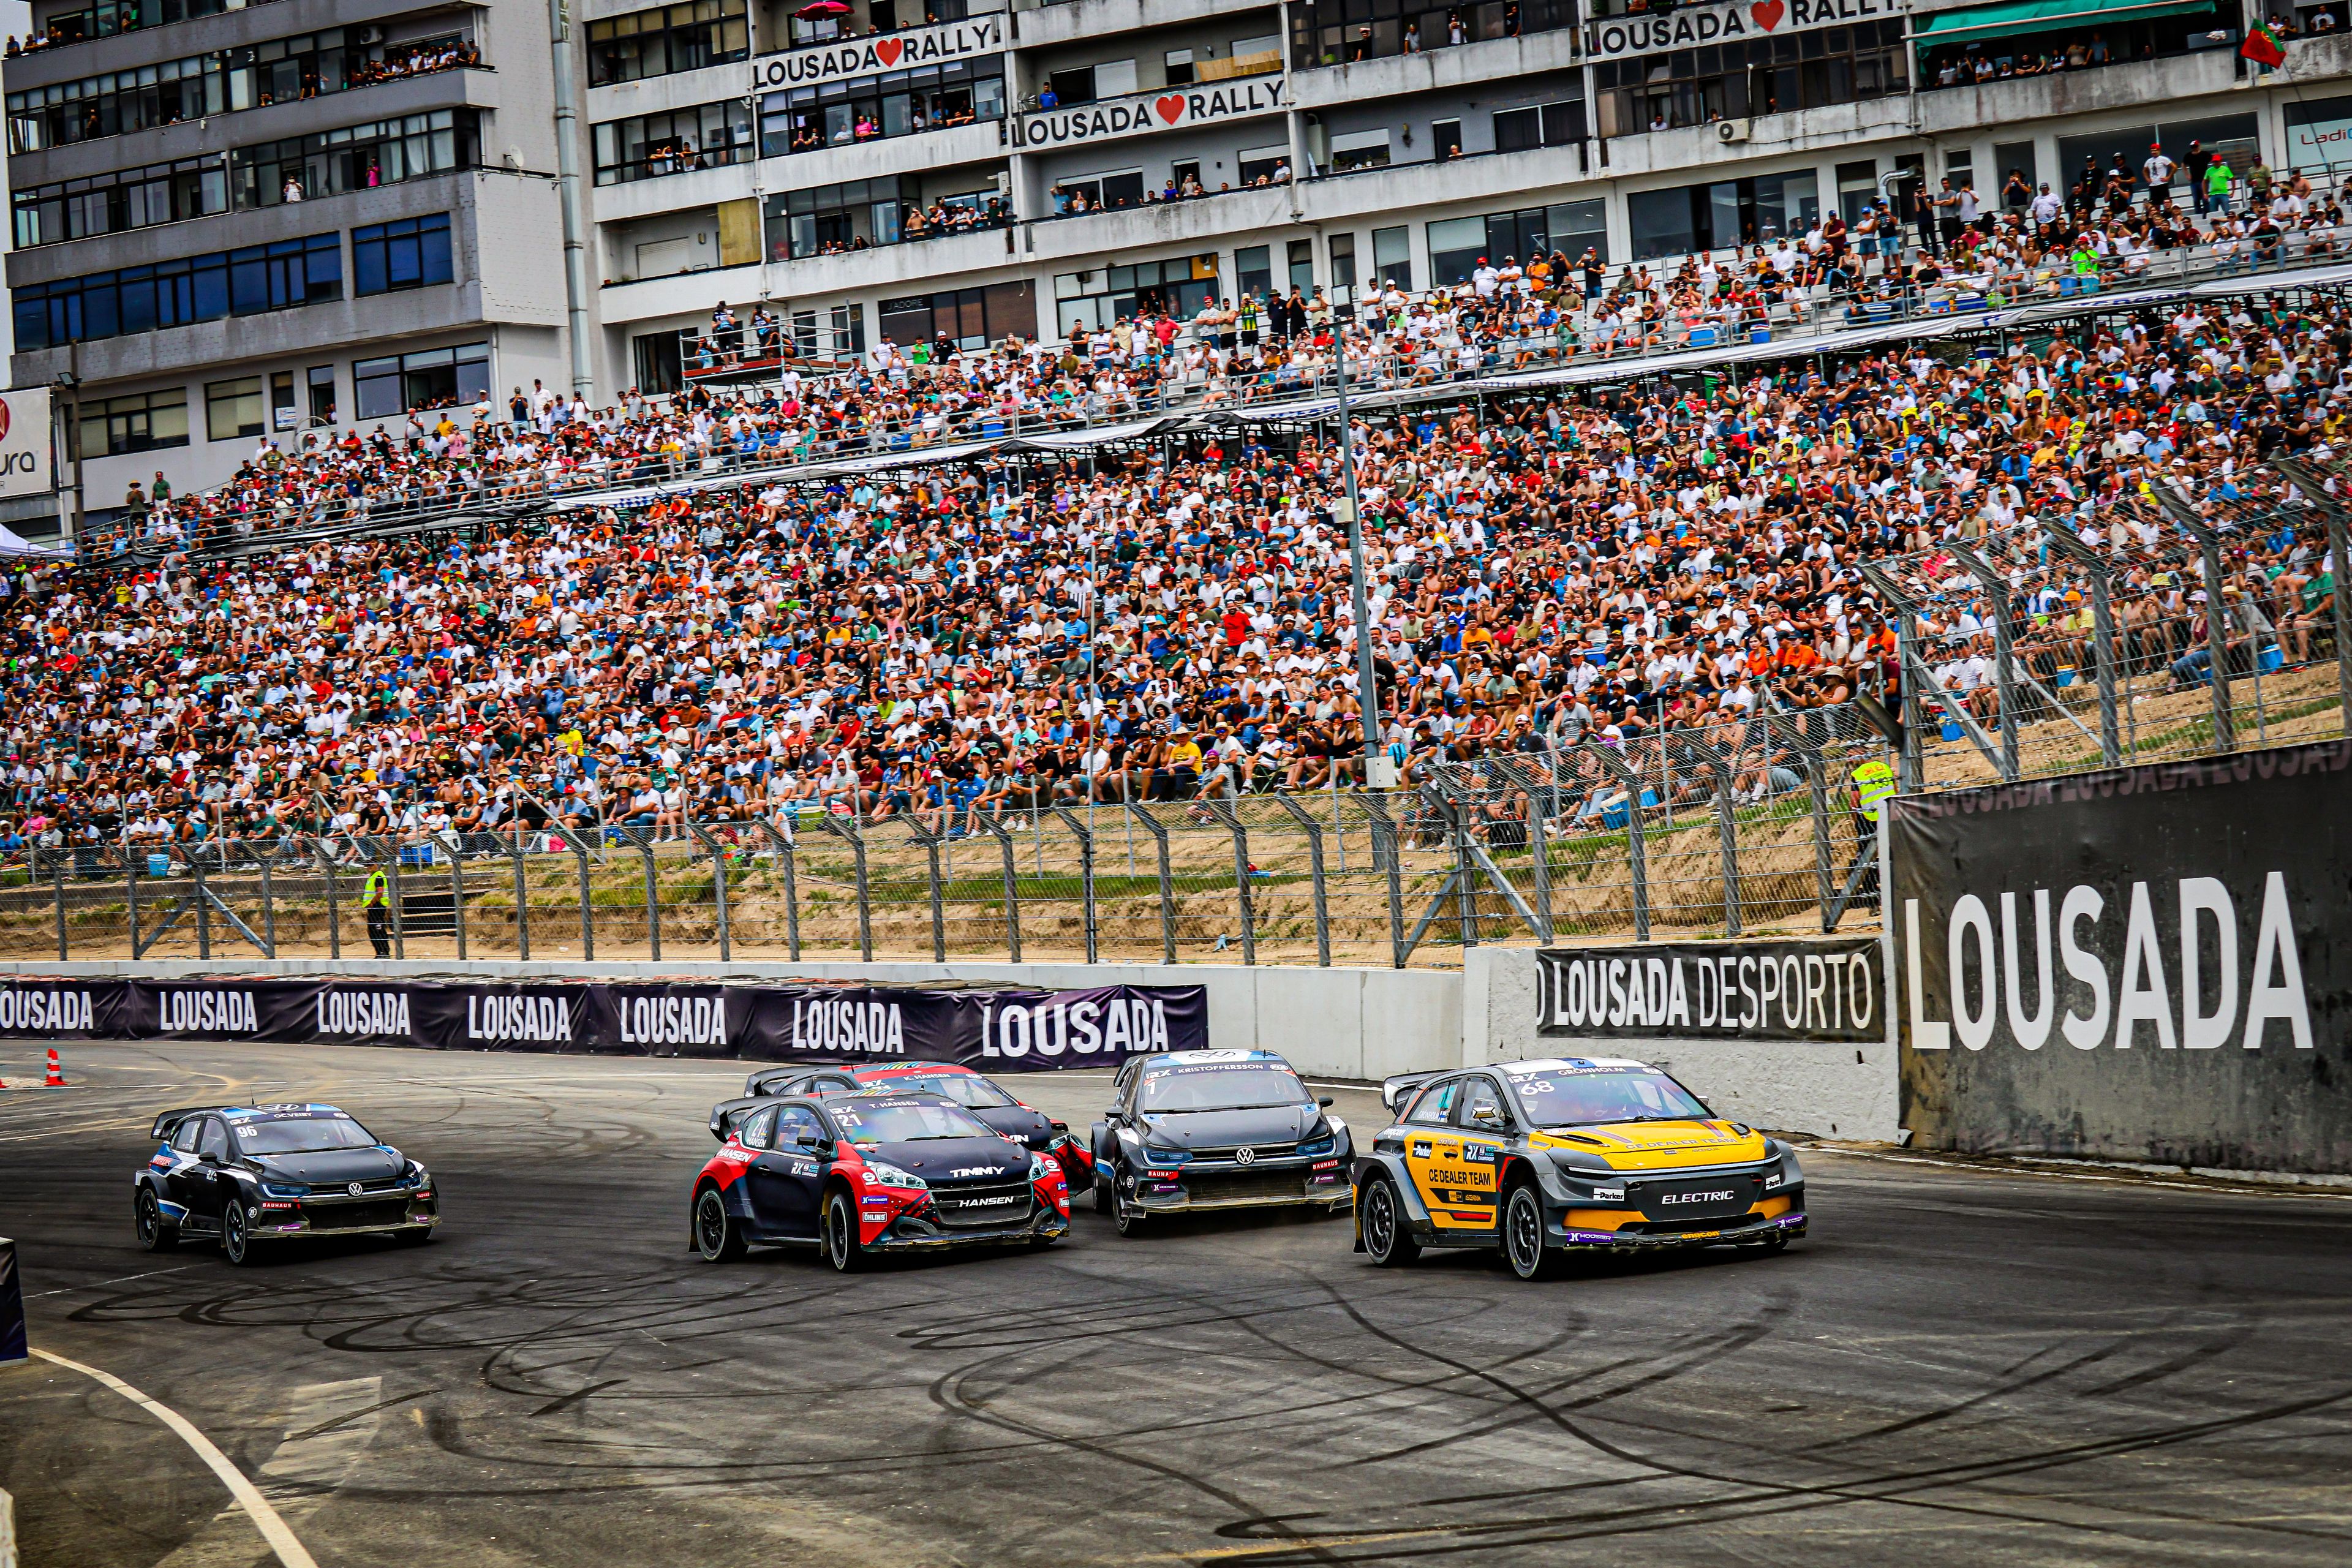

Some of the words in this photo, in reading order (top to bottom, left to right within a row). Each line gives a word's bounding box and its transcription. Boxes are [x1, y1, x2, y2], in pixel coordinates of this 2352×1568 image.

[1585, 8, 1745, 56] LOUSADA
[753, 45, 880, 88] LOUSADA
[903, 23, 991, 62] RALLY
[1012, 103, 1152, 148] LOUSADA
[1189, 80, 1284, 120] RALLY
[1905, 871, 2313, 1051] LOUSADA
[1553, 958, 1691, 1027] LOUSADA
[1698, 952, 1873, 1030] DESPORTO
[0, 990, 94, 1030] OUSADA
[160, 991, 258, 1031] LOUSADA
[317, 992, 411, 1035] LOUSADA
[469, 995, 572, 1041] LOUSADA
[620, 997, 727, 1045] LOUSADA
[792, 1000, 905, 1054] LOUSADA
[982, 999, 1169, 1057] LOUSADA
[1178, 1064, 1264, 1074] KRISTOFFERSSON
[1558, 1067, 1627, 1076] GRÖNHOLM
[1148, 1082, 1156, 1095] 1
[1520, 1080, 1555, 1095] 68
[751, 1114, 768, 1137] 21
[837, 1114, 862, 1126] 21
[237, 1126, 258, 1137] 96
[746, 1136, 767, 1147] HANSEN
[1646, 1139, 1699, 1148] DEALER
[715, 1148, 753, 1163] HANSEN
[1237, 1148, 1254, 1164] VW
[1413, 1145, 1431, 1157] Parker
[1313, 1159, 1338, 1169] BAUHAUS
[949, 1166, 1006, 1178] TIMMY
[1428, 1169, 1438, 1182] CE
[1439, 1170, 1468, 1185] DEALER
[1469, 1172, 1491, 1186] TEAM
[349, 1183, 363, 1196] VW
[959, 1196, 1015, 1207] HANSEN
[1661, 1190, 1734, 1205] ELECTRIC
